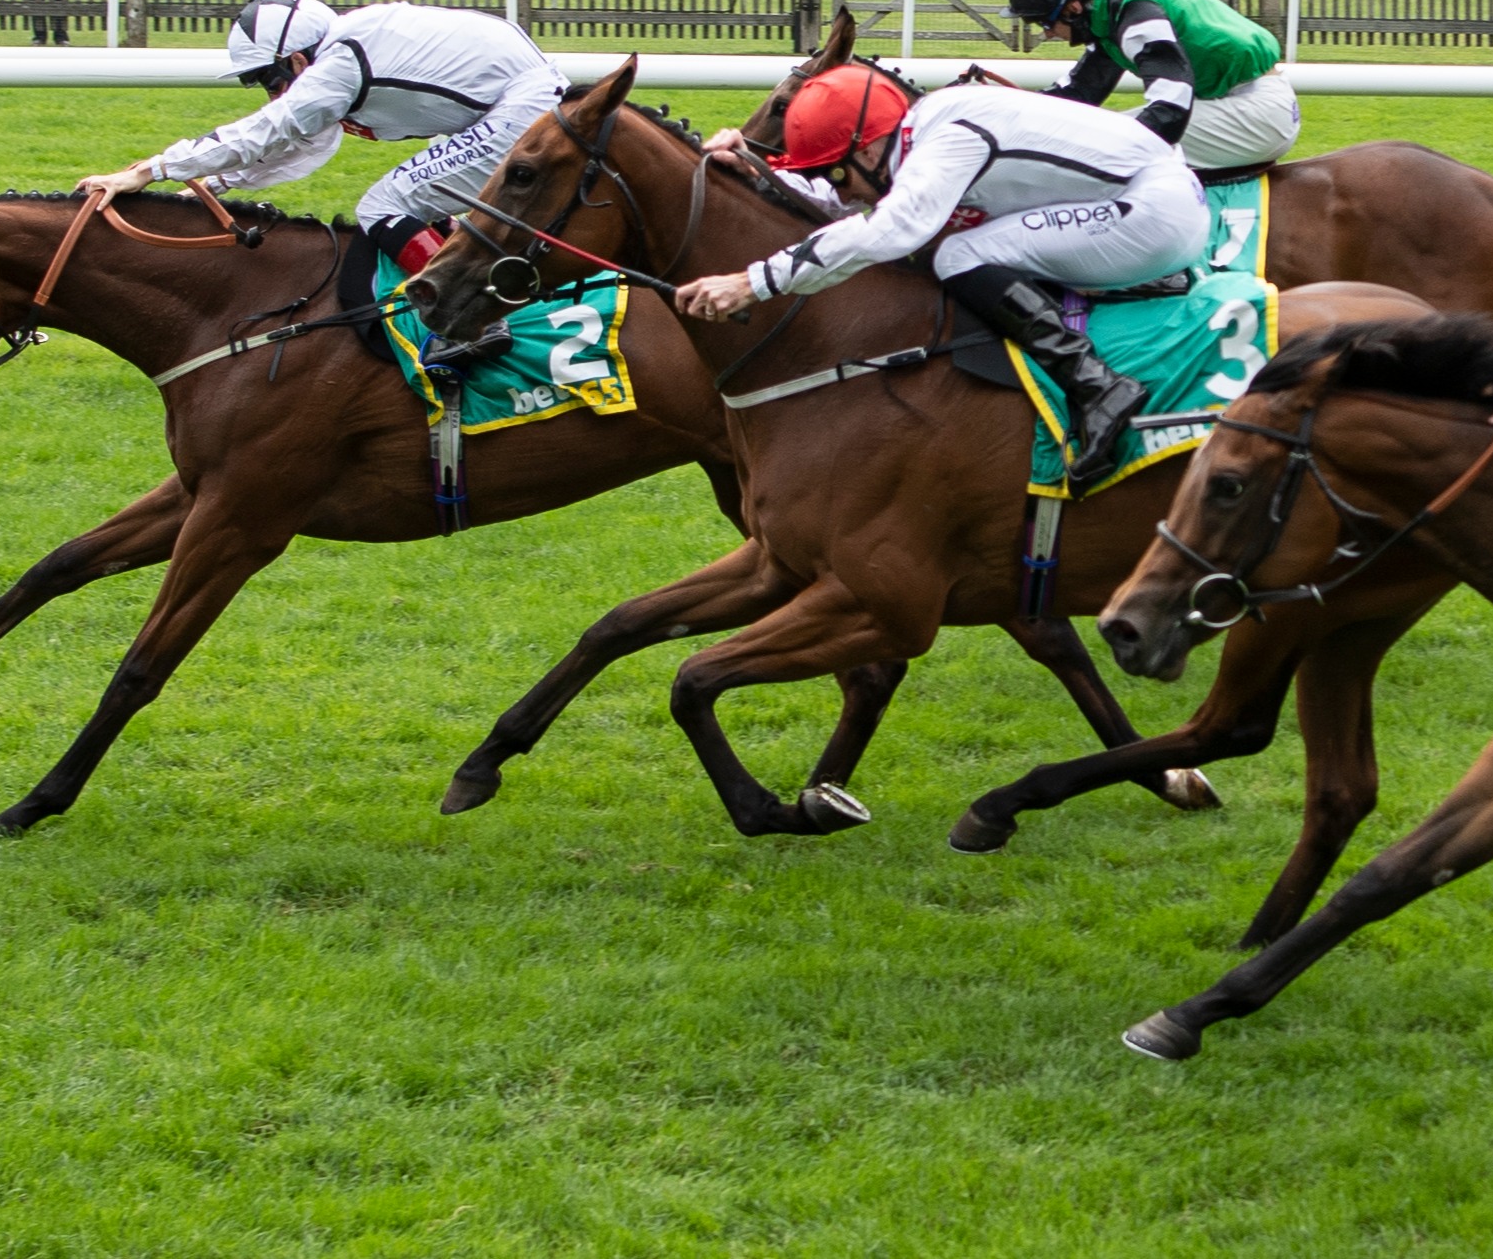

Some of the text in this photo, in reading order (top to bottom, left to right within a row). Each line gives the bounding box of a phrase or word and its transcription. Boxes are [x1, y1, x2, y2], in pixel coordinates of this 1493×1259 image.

[392, 121, 497, 181] ALBASTI
[408, 144, 495, 184] EQUIWORLD
[1021, 204, 1116, 232] Clipper
[1207, 208, 1256, 267] 7
[547, 304, 611, 385] 2
[1205, 298, 1268, 401] 3
[507, 377, 623, 414] bet65
